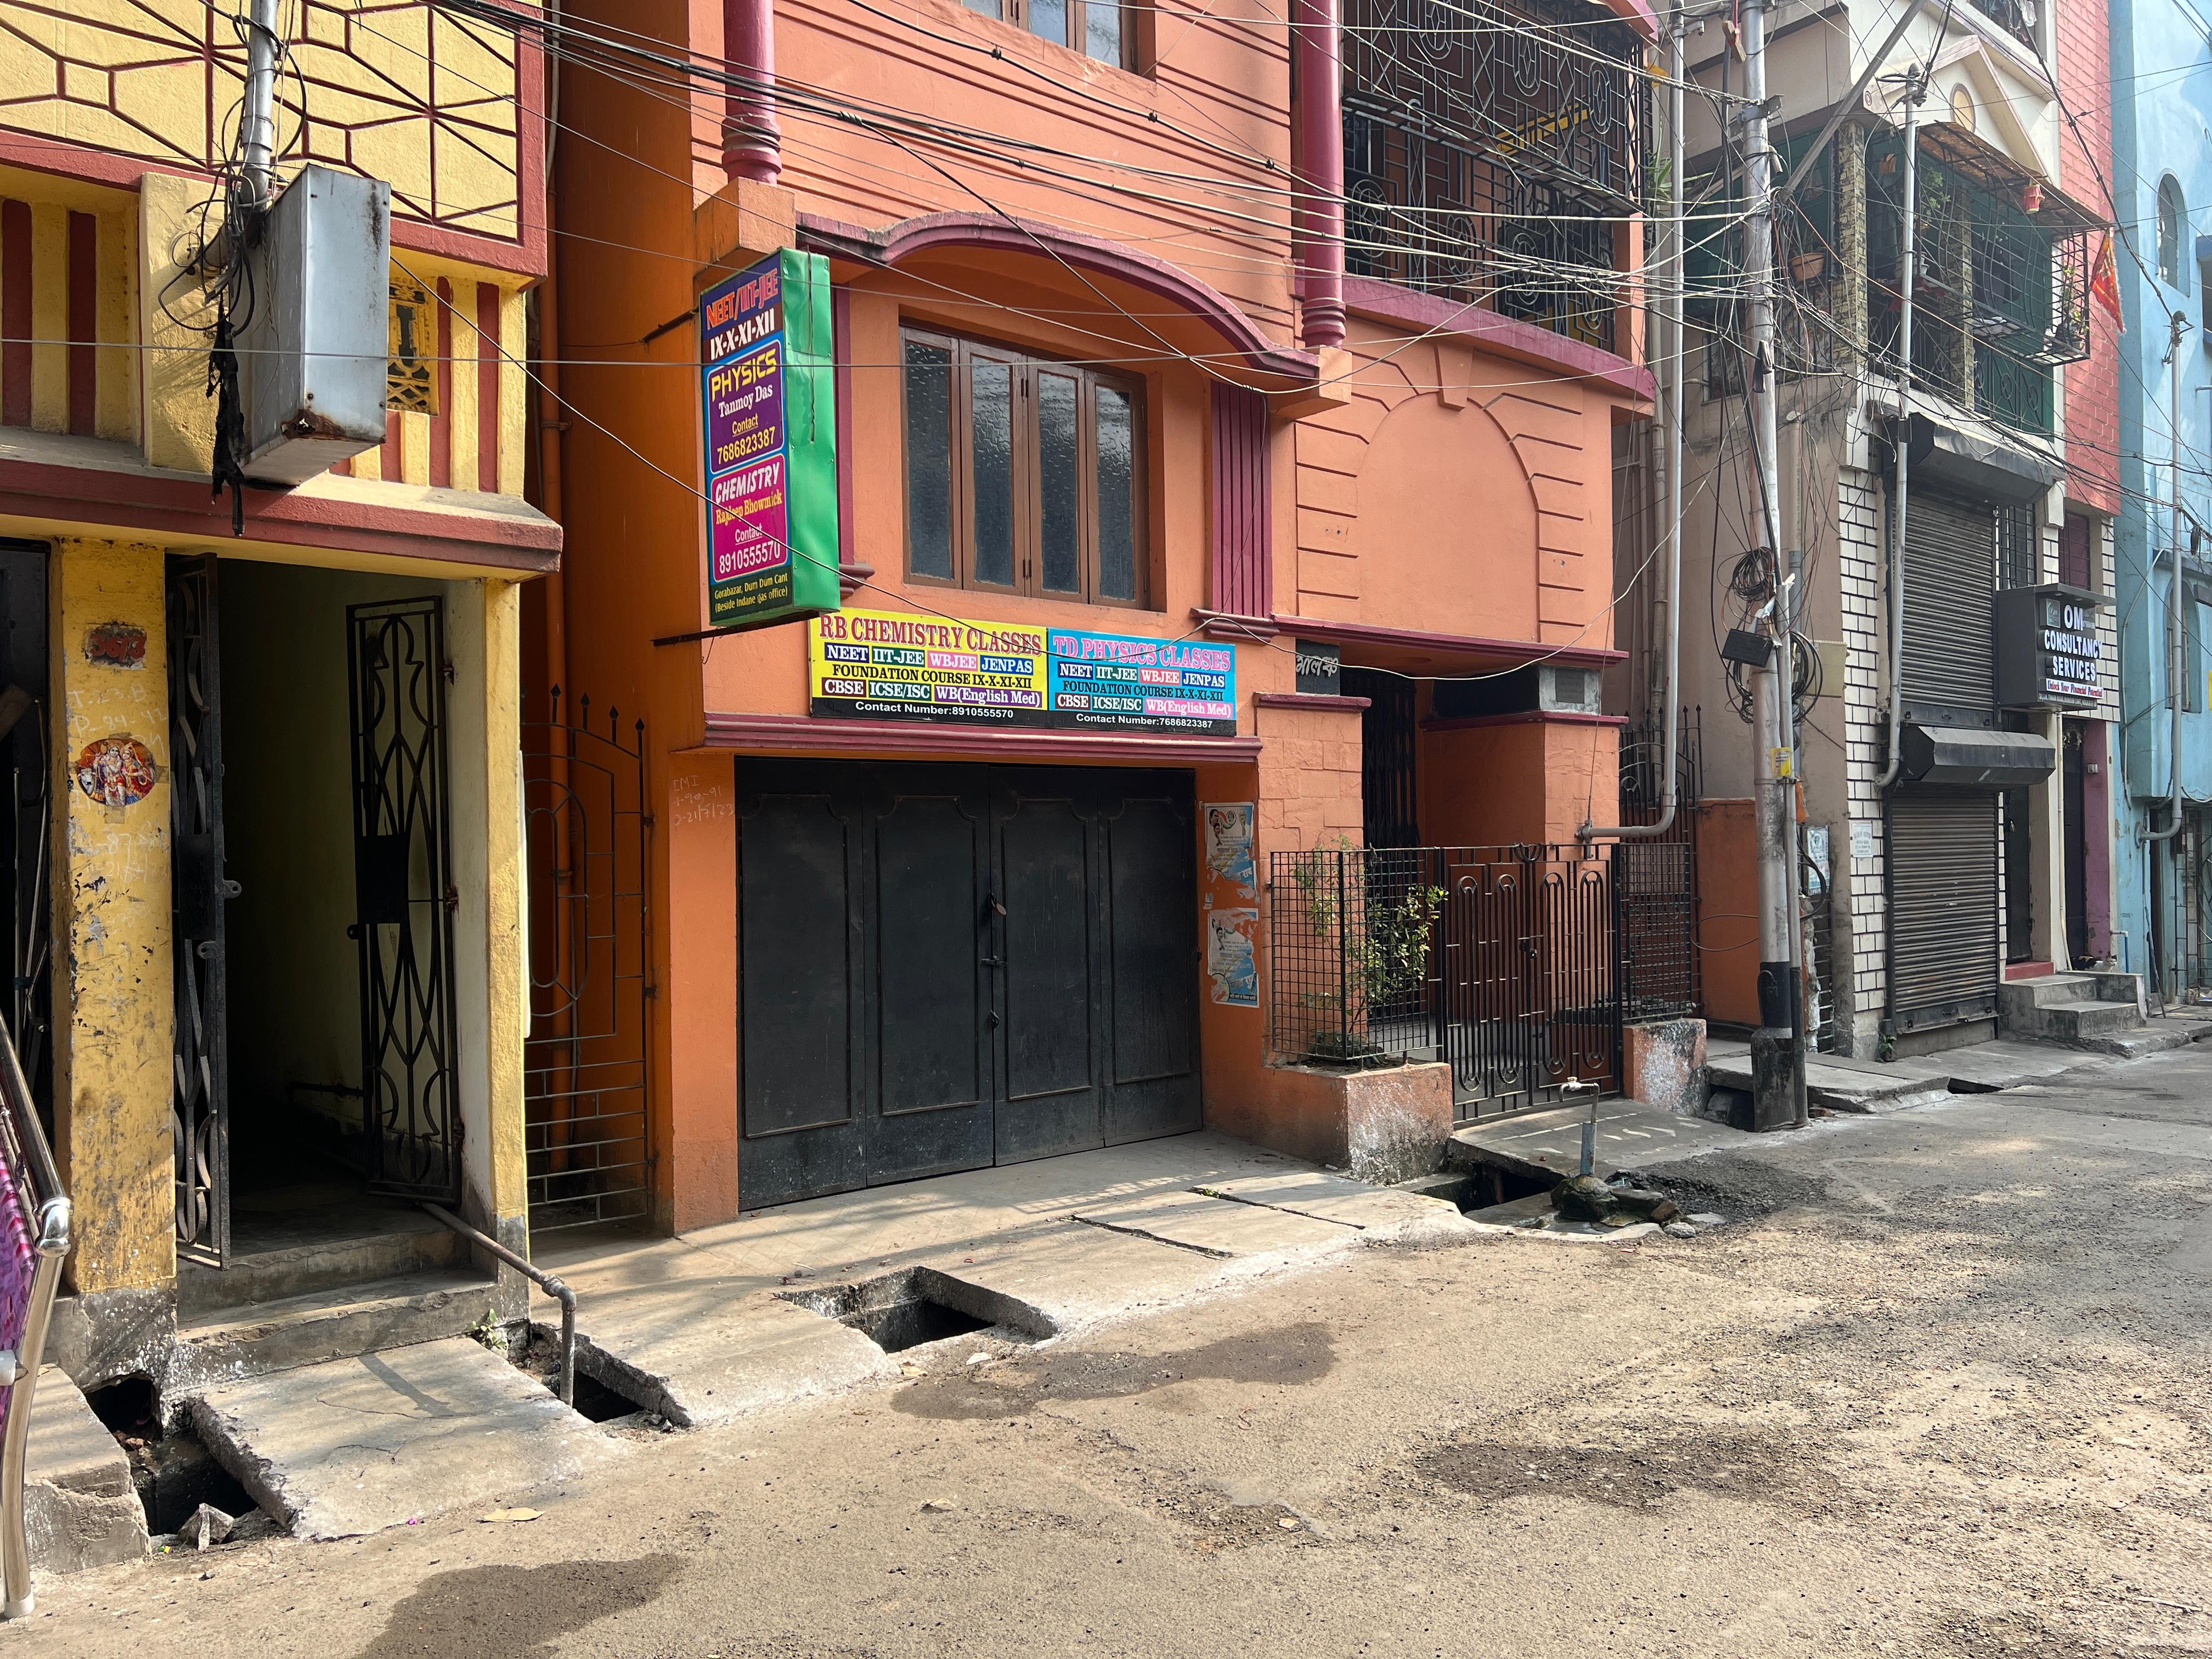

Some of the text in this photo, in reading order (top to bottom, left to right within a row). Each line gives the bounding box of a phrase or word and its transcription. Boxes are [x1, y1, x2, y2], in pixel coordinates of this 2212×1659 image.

[707, 268, 778, 330] NEET/IIT-JEE
[710, 308, 775, 360] IX-X-XI-XII
[712, 348, 776, 402] PHYSICS
[719, 385, 772, 417] Tanmoy Das
[732, 413, 758, 435] Contact
[718, 426, 775, 465] 7686823387
[716, 461, 780, 504] CHEMISTRY
[716, 489, 782, 527] Rajdeep Bhowmick
[735, 523, 762, 543] Contact
[719, 539, 780, 574] 8910555570
[714, 573, 788, 599] Gorabazar, Dum Dum Cant
[715, 586, 788, 614] (Beside Indane gas office)
[2064, 605, 2083, 631] OM
[820, 615, 1041, 656] RB CHEMISTRY CLASSES
[2045, 629, 2102, 659] CONSULTANCY
[827, 645, 1032, 674] NEET IIT-JEE WBJEE JENPAS
[1054, 636, 1231, 672] TD PHYSICS CLASSES
[832, 664, 1031, 689] FOUNDATION COURSE IX-X-XI-XII
[1059, 664, 1224, 687] NEET IIT-JEE WBJEE JENPAS
[2053, 656, 2096, 681] SERVICES
[824, 680, 1040, 707] CBSE ICSE/ISC WB(English Med)
[1063, 681, 1223, 701] FOUNDATION COURSE IX-X-XI-XII
[2061, 682, 2069, 692] Your
[855, 702, 1013, 718] Contact Number:8910555570
[1057, 695, 1231, 718] CBSE ICSE/ISC WB(English Med)
[1076, 714, 1212, 728] Contact Number:7686823387
